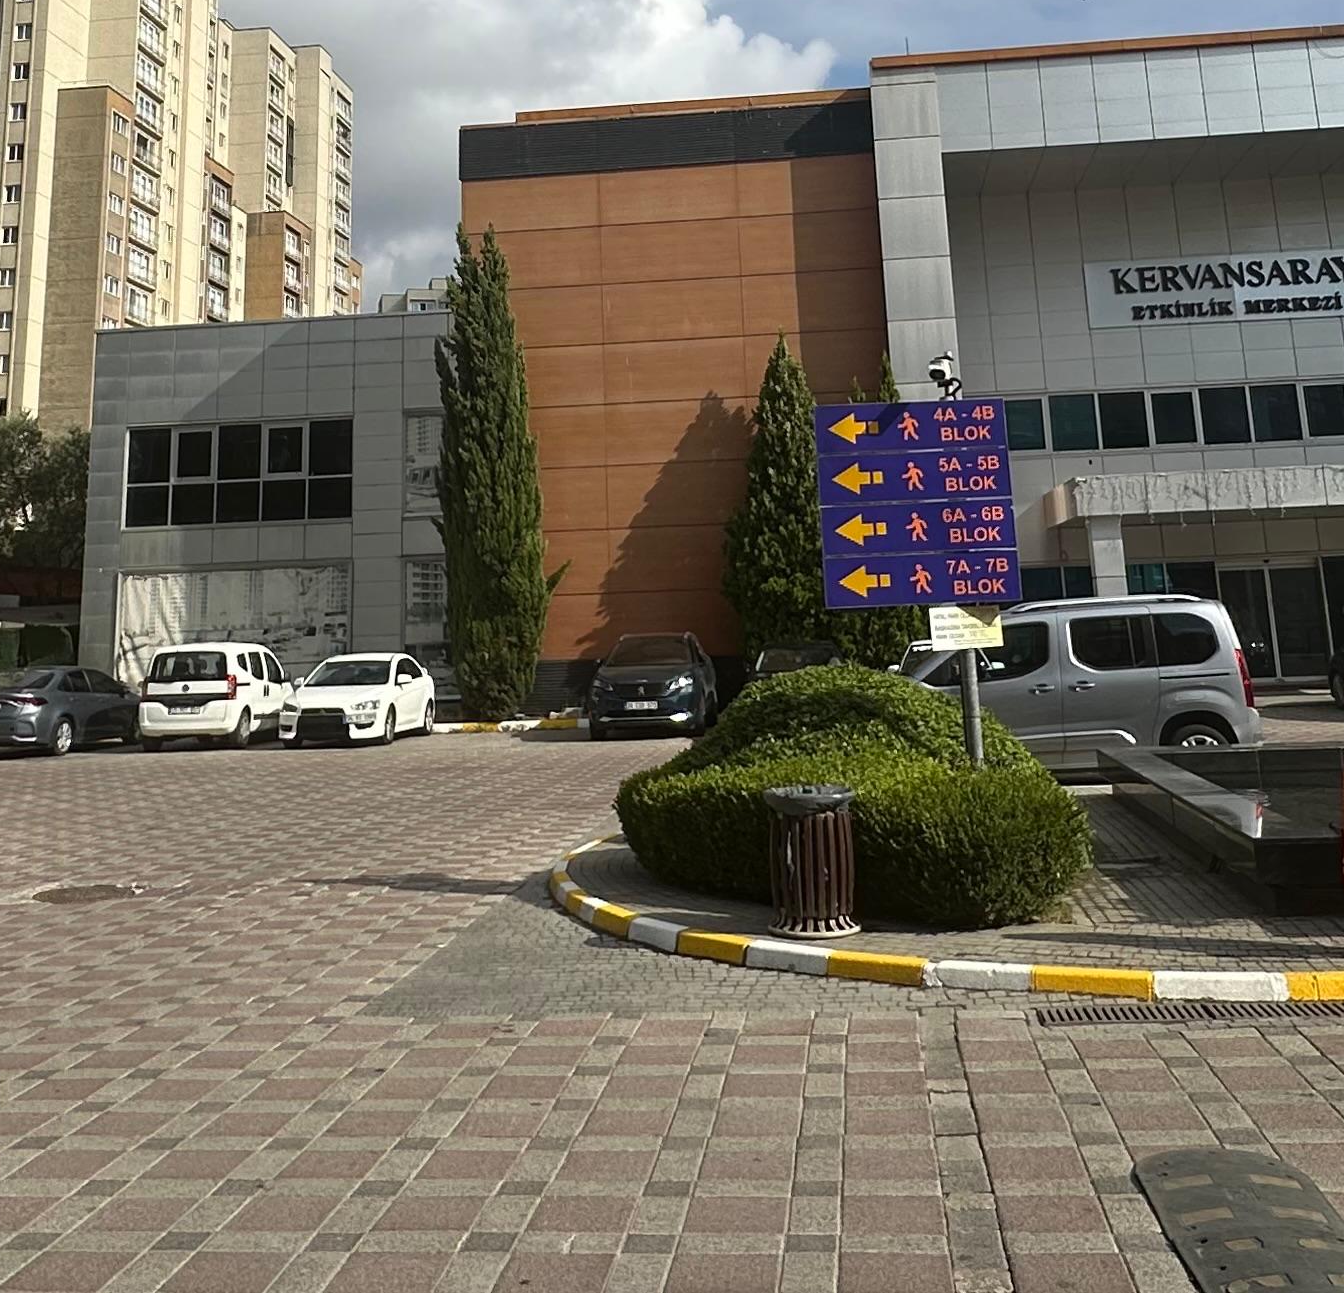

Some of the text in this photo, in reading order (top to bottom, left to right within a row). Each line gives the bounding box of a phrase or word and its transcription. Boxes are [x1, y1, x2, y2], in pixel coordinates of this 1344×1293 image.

[1131, 292, 1344, 321] ETKİNLİK MERKEZİ
[933, 407, 957, 422] 4A
[971, 405, 995, 420] 4B
[940, 425, 992, 442] BLOK
[938, 457, 962, 472] 5A
[977, 455, 1000, 470] 5B
[945, 475, 997, 492] BLOK
[942, 508, 967, 523] 6A
[981, 506, 1005, 521] 6B
[949, 526, 1001, 543] BLOK
[946, 559, 971, 575] 7A
[985, 558, 1009, 573] 7B
[953, 578, 1006, 595] BLOK
